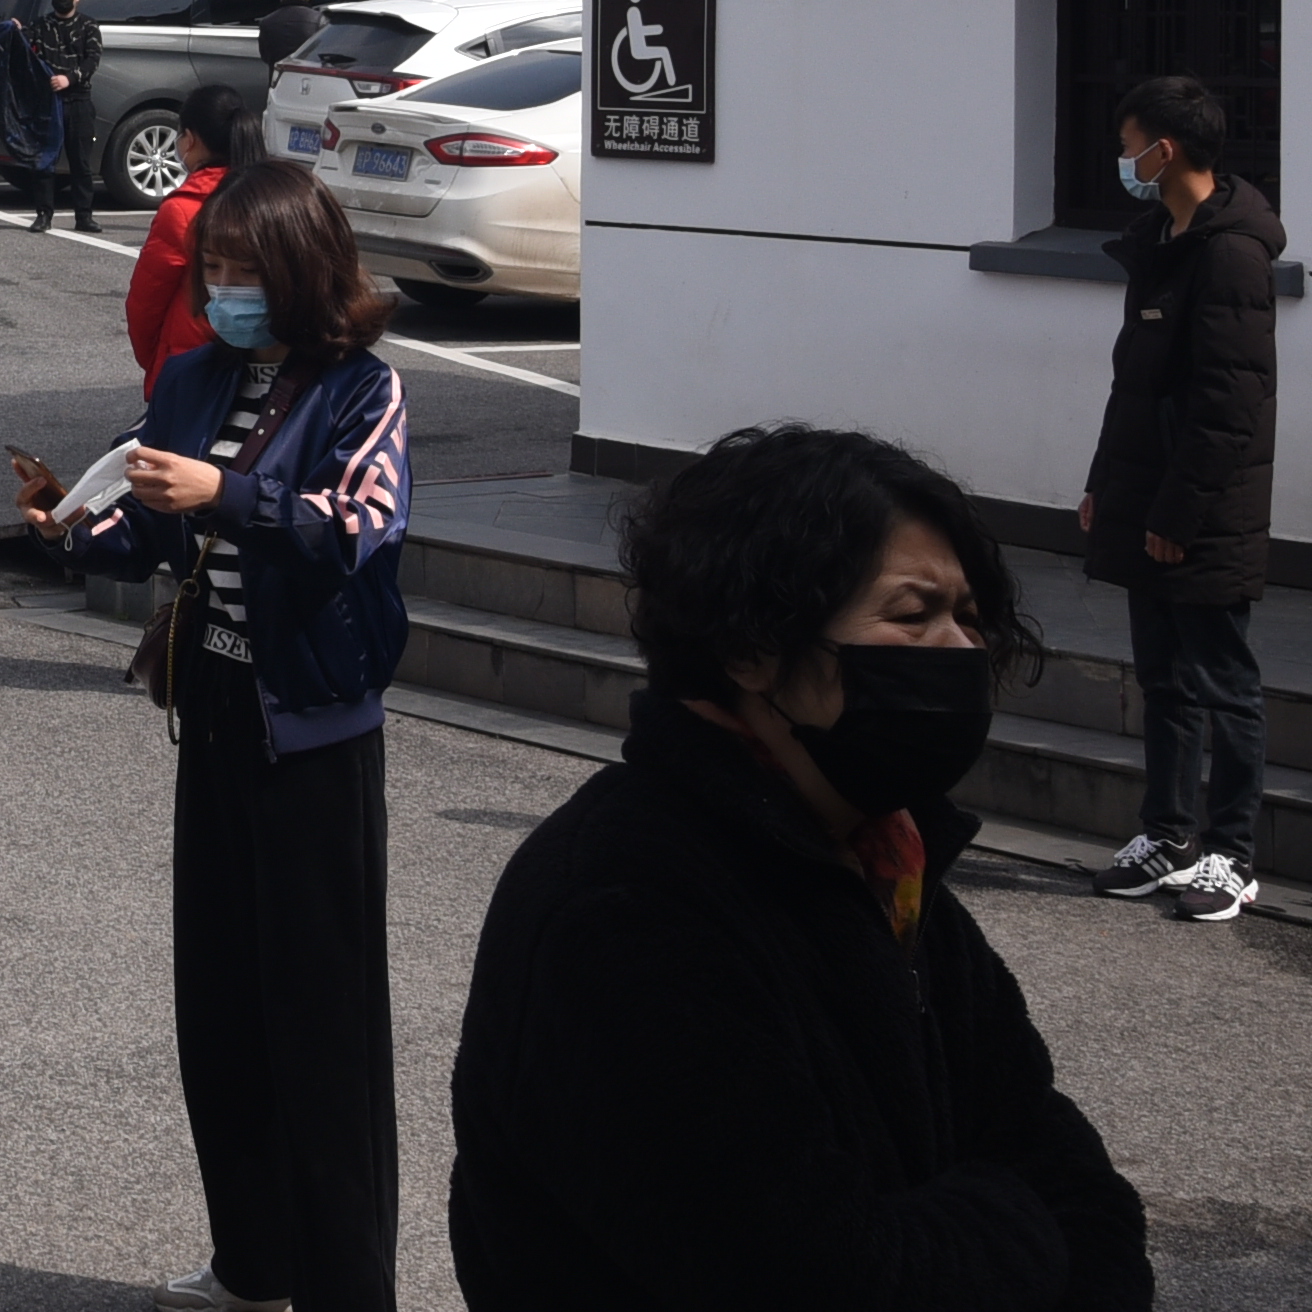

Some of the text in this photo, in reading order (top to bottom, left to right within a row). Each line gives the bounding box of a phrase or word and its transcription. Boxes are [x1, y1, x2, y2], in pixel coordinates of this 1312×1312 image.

[604, 114, 700, 142] 无障碍通道
[604, 139, 701, 155] Wheelchair Accessible
